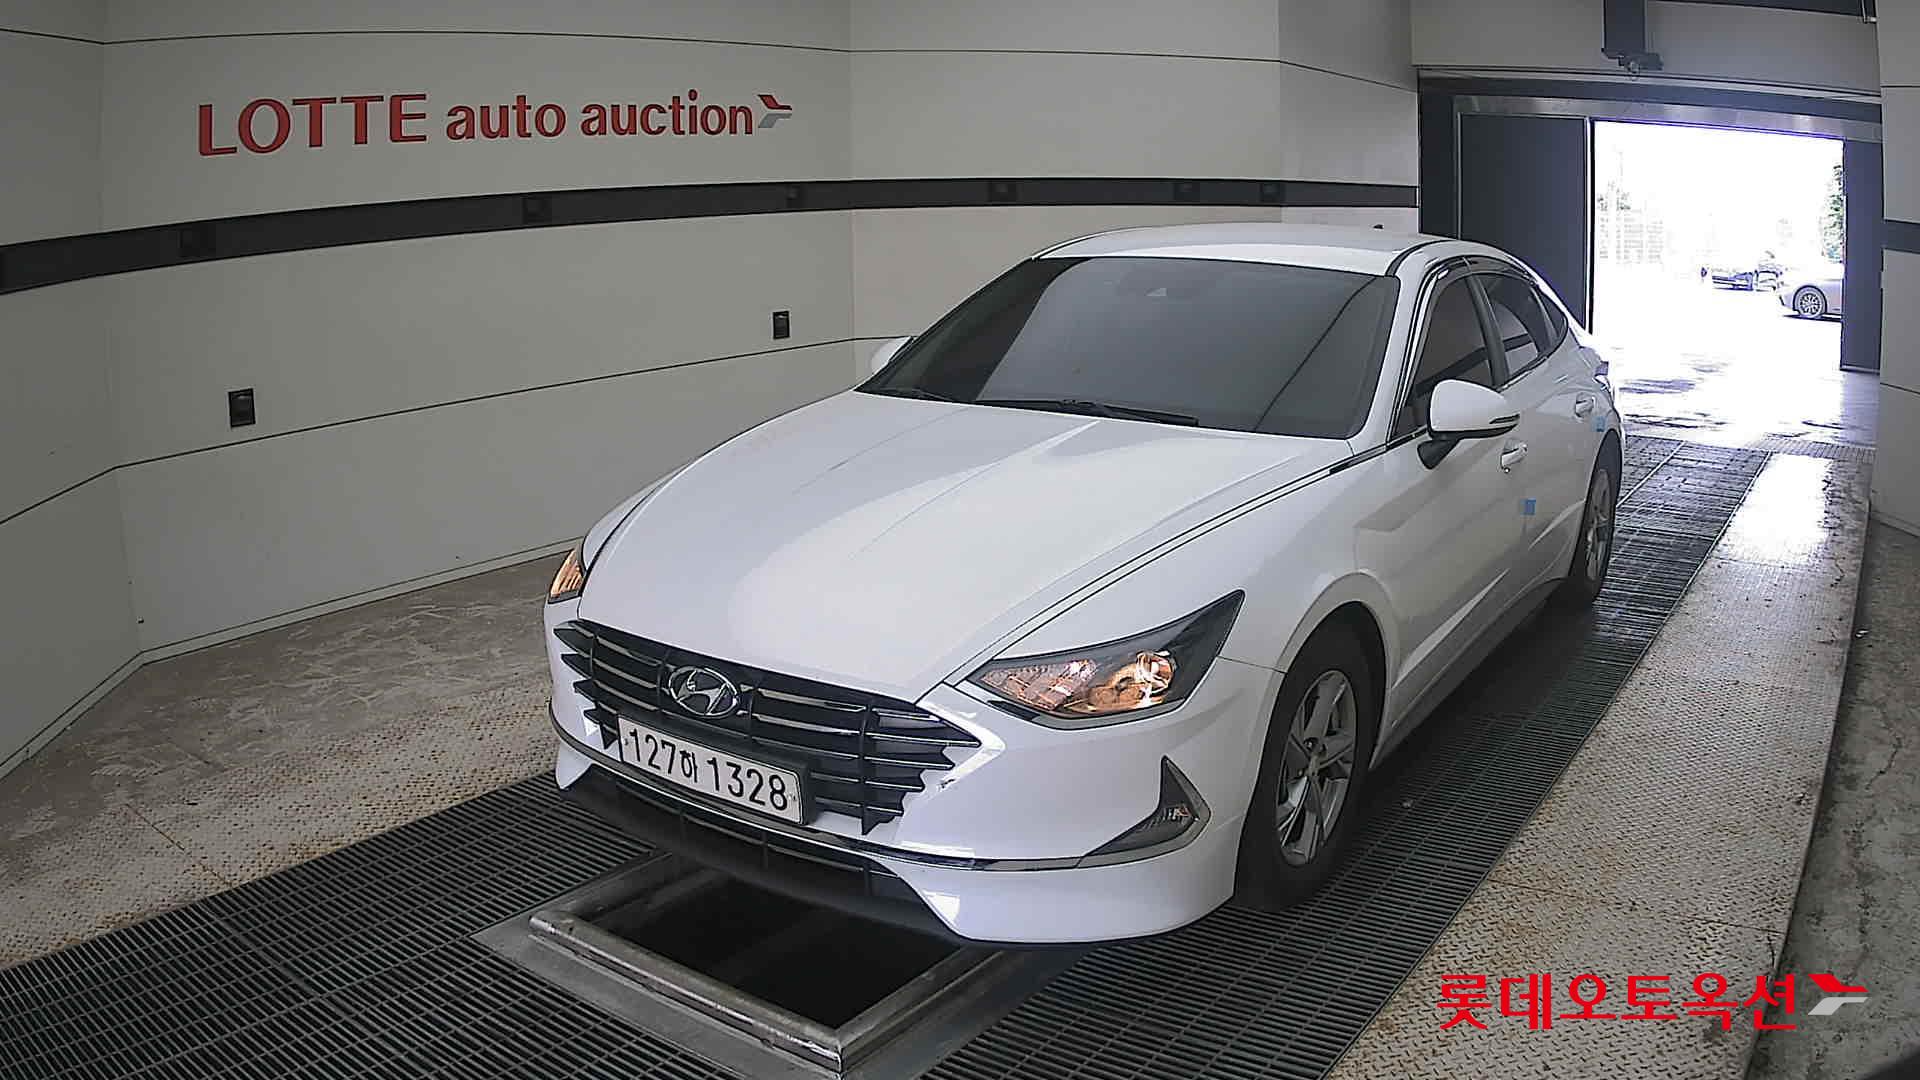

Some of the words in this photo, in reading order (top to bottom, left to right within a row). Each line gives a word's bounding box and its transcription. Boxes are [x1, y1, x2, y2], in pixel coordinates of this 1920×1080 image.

[199, 93, 427, 156] LOTTE
[446, 94, 566, 140] auto
[580, 89, 753, 136] auction
[706, 757, 788, 811] 1328
